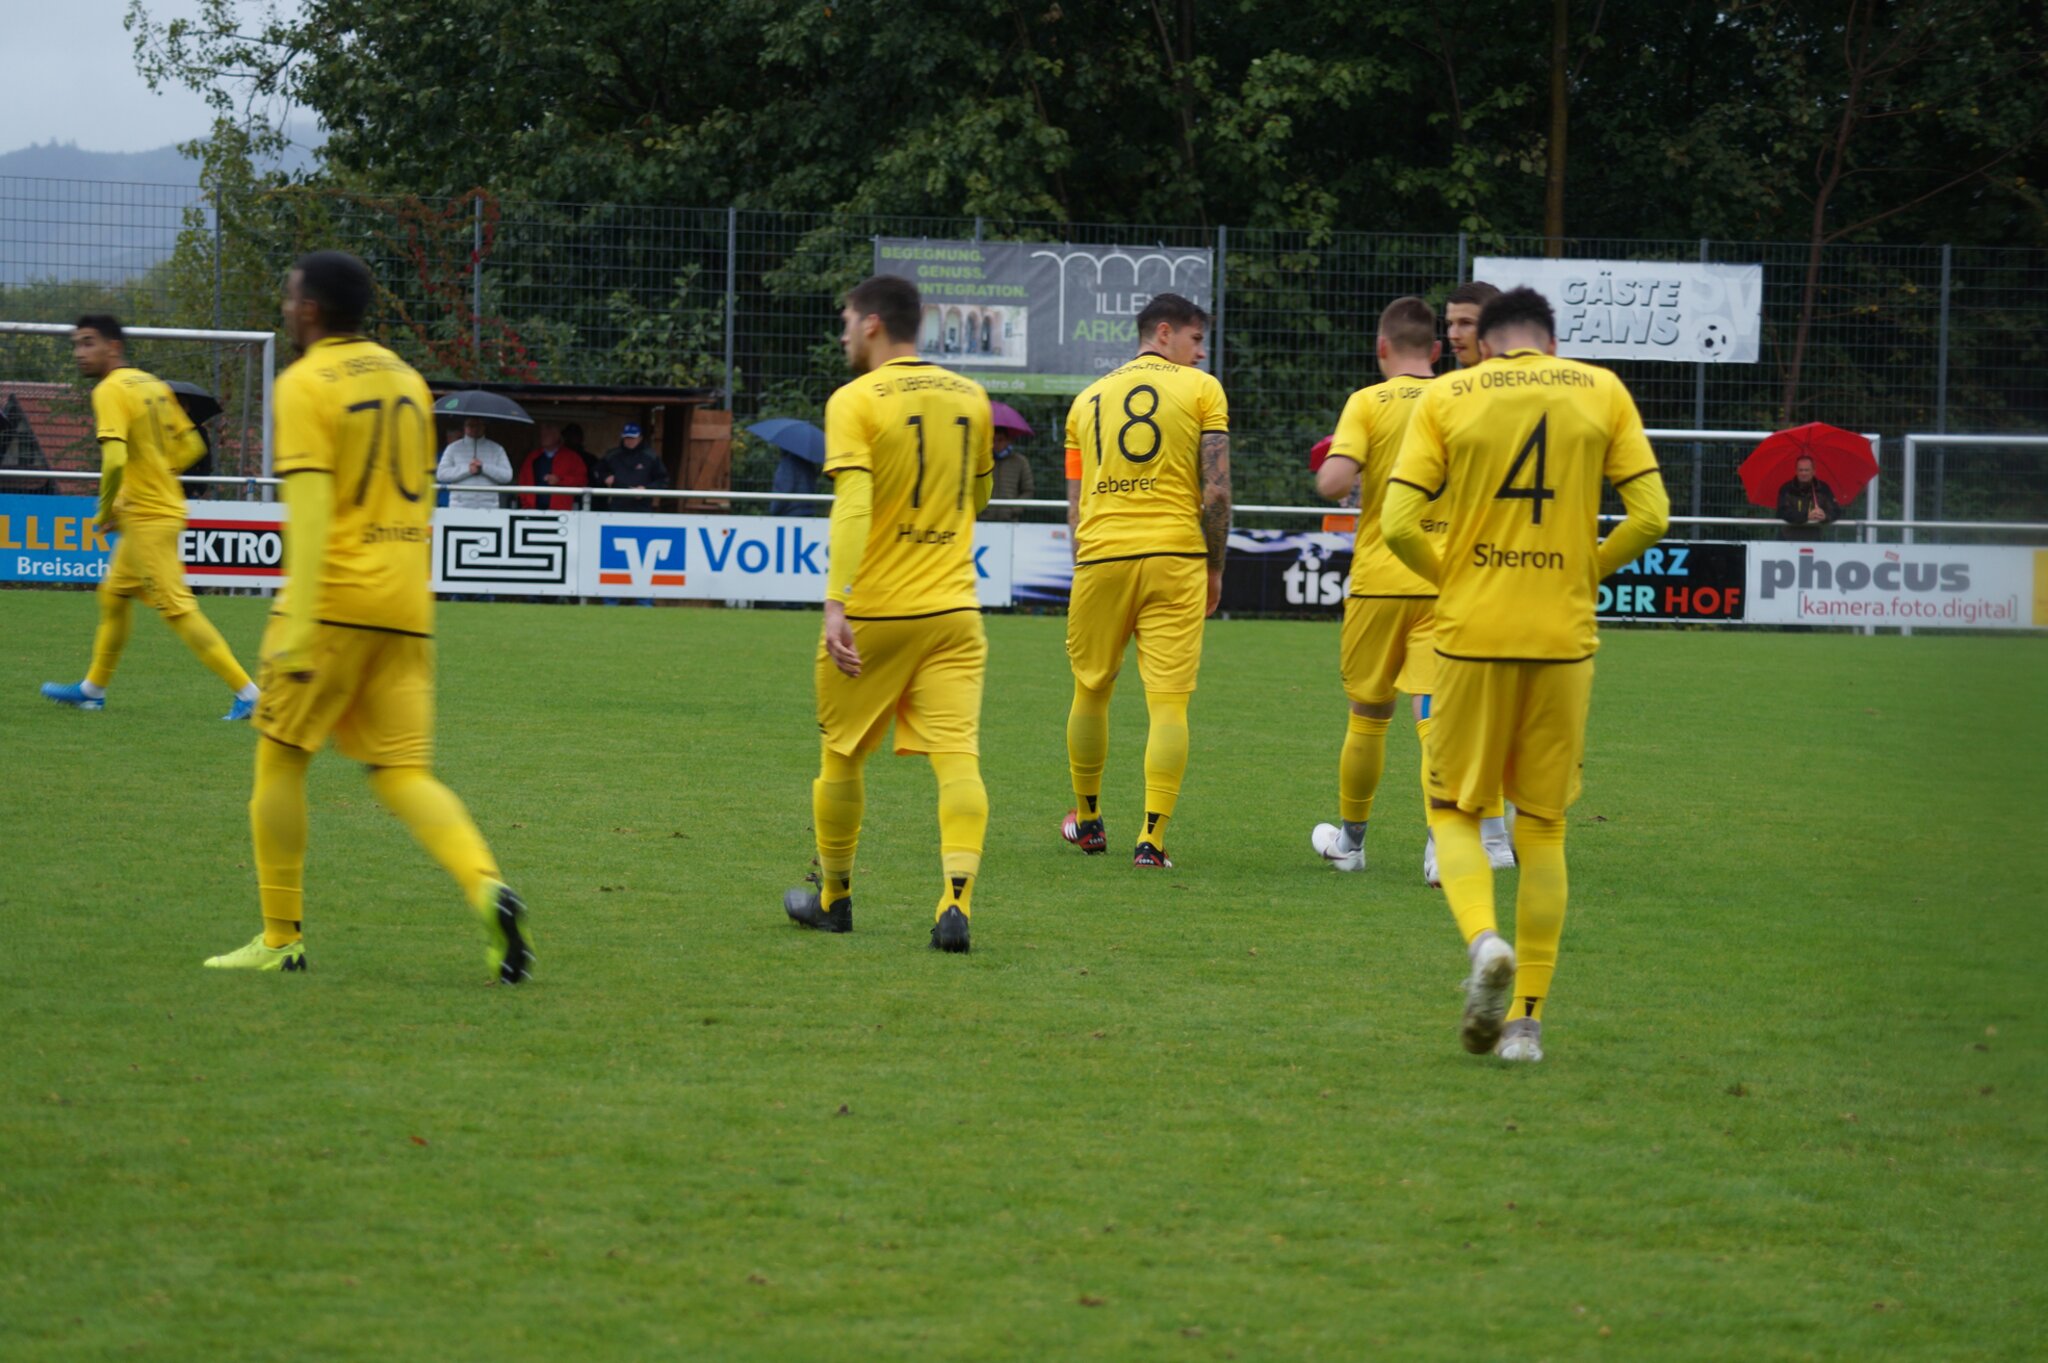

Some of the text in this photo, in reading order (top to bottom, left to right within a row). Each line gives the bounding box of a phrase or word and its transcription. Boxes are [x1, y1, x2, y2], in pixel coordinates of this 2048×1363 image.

[880, 246, 986, 263] BEGEGNUNG.
[917, 264, 987, 279] GENUSS.
[1561, 271, 1682, 308] GÄSTE
[1559, 308, 1682, 346] FANS
[1452, 369, 1595, 396] SV OBERACHERN
[1089, 384, 1162, 464] 18
[346, 395, 428, 507] 70
[906, 415, 970, 512] 11
[1493, 410, 1555, 526] 4
[1091, 475, 1157, 495] eberer
[896, 523, 958, 545] Huber
[1472, 543, 1564, 570] Sheron
[1664, 586, 1741, 615] HOF
